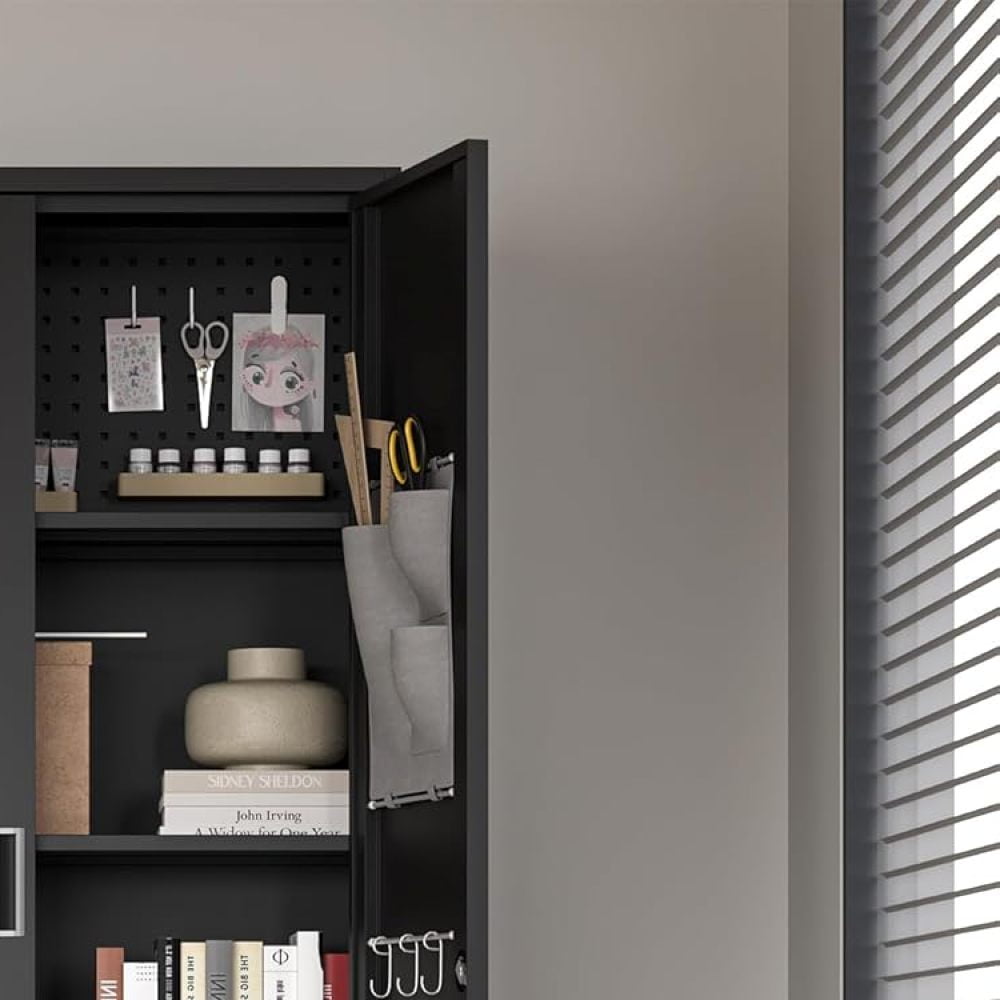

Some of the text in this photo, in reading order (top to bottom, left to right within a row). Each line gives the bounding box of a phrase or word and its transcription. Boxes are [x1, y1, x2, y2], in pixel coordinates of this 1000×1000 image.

[207, 774, 323, 788] SIDNEY SHELDON
[236, 809, 302, 823] John Irving
